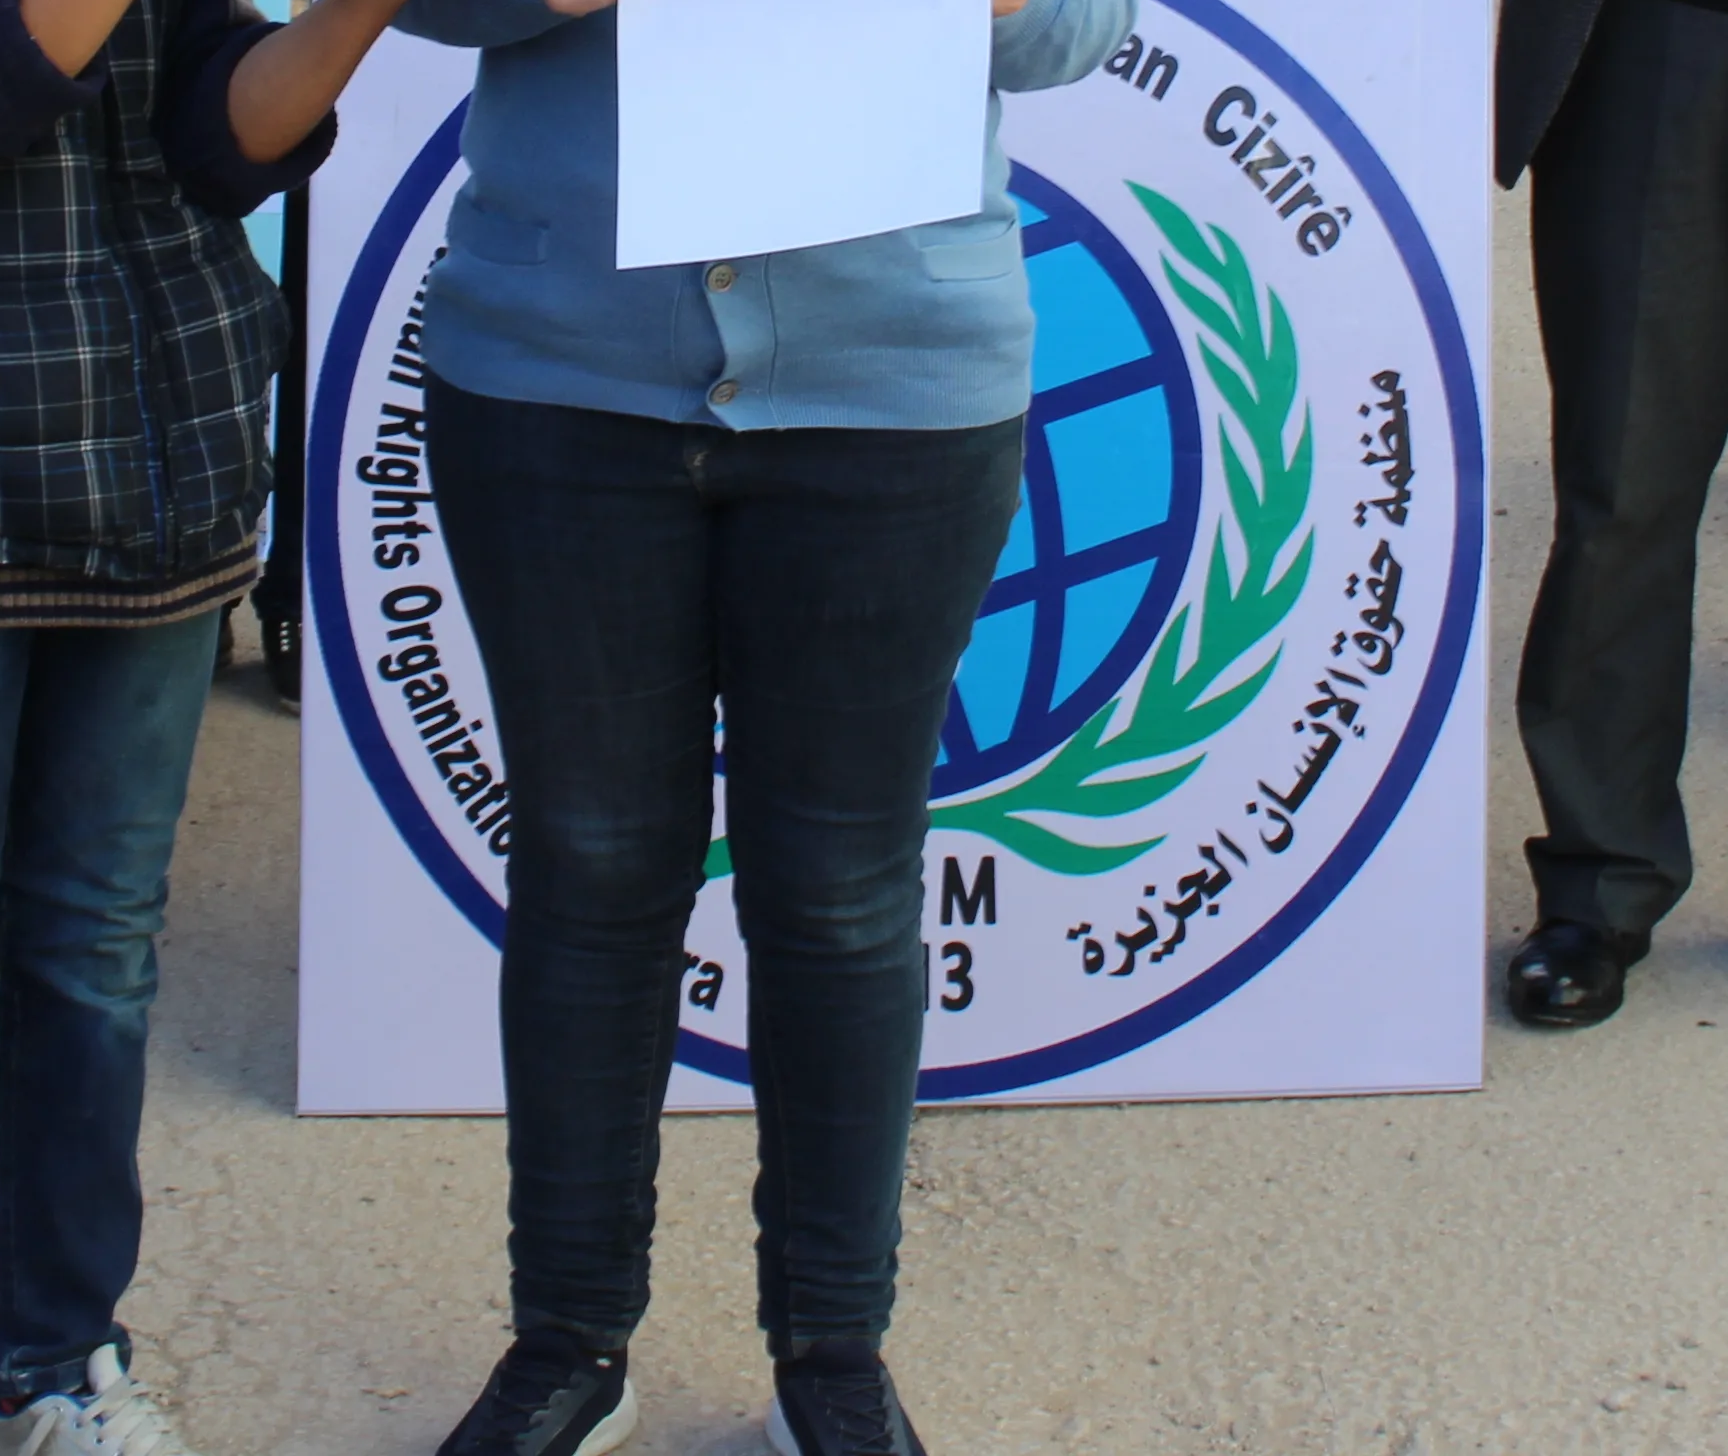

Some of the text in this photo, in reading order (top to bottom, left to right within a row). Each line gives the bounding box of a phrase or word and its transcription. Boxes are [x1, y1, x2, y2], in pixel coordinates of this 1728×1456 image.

[1204, 85, 1352, 257] Cizîrê
[356, 403, 436, 569] Rights
[377, 584, 511, 856] Organizatio
[1067, 369, 1414, 976] منظمة حقوق الإنسان الجزيرة
